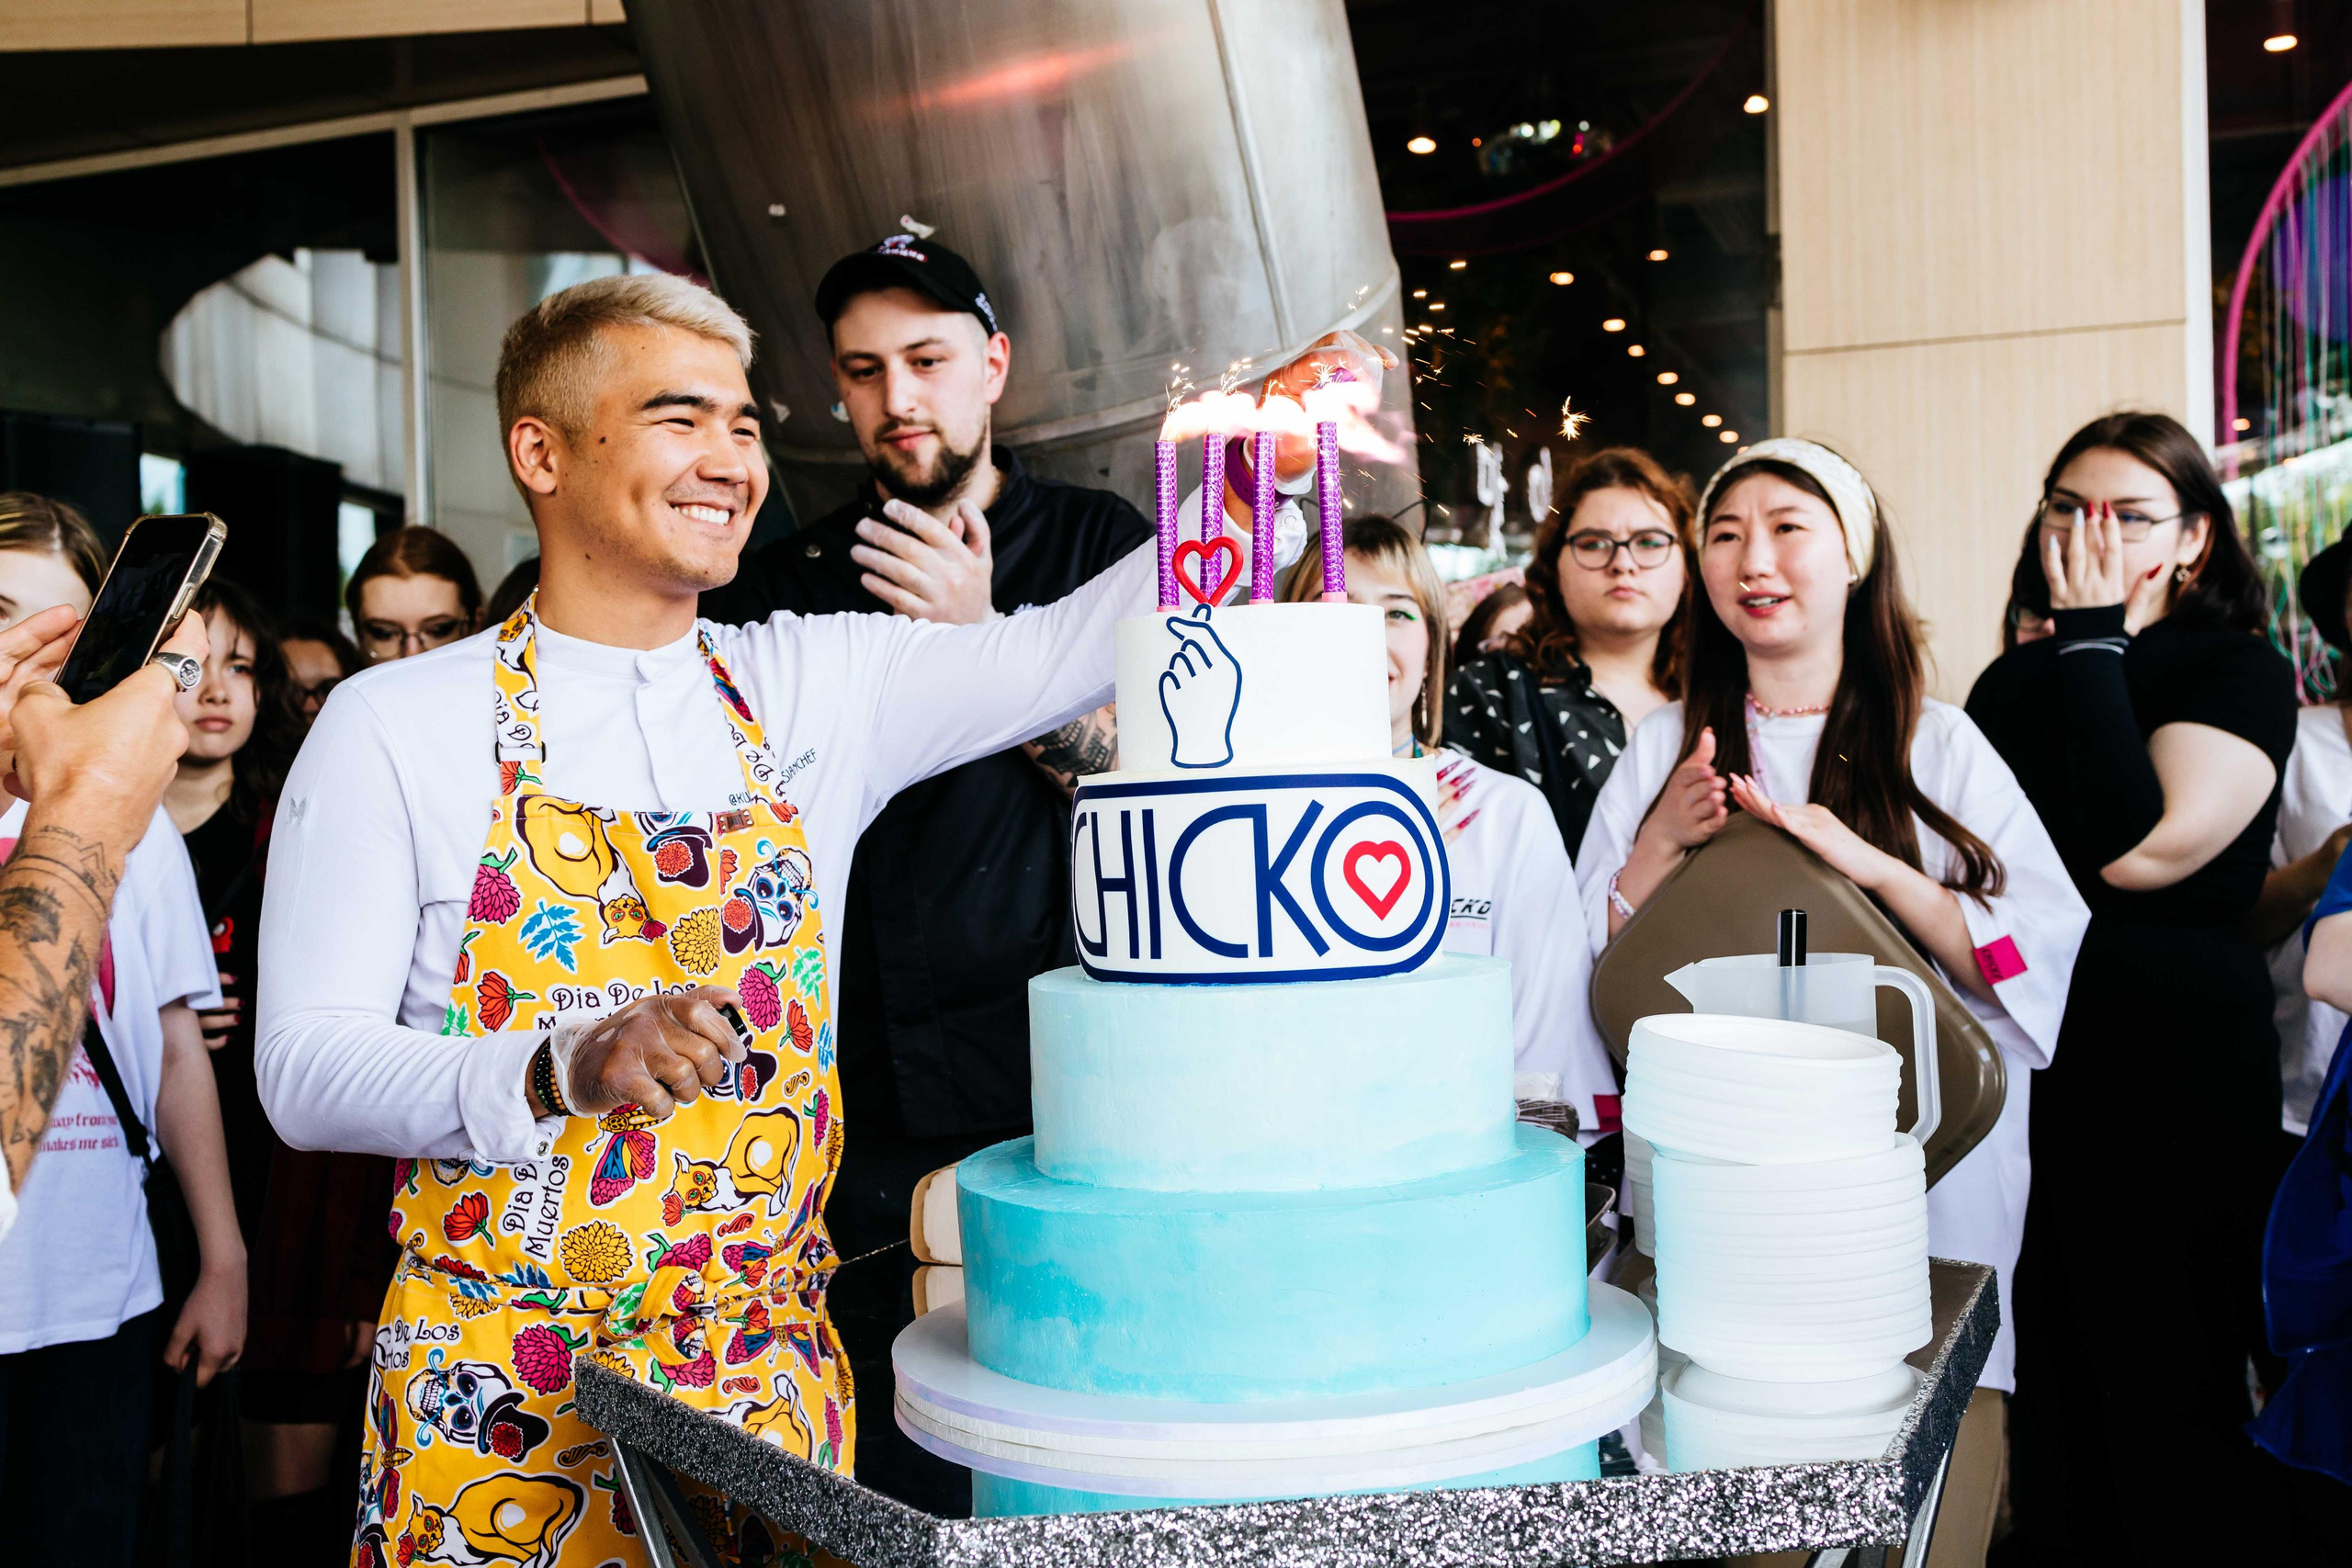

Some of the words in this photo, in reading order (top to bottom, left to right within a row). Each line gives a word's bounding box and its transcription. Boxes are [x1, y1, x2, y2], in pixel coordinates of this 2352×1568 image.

[1071, 798, 1435, 960] CHICKO
[1451, 898, 1492, 915] CKO
[551, 987, 601, 1011] Dia
[503, 1191, 534, 1232] Dia
[525, 1156, 570, 1259] Muertos
[414, 1319, 459, 1341] Los
